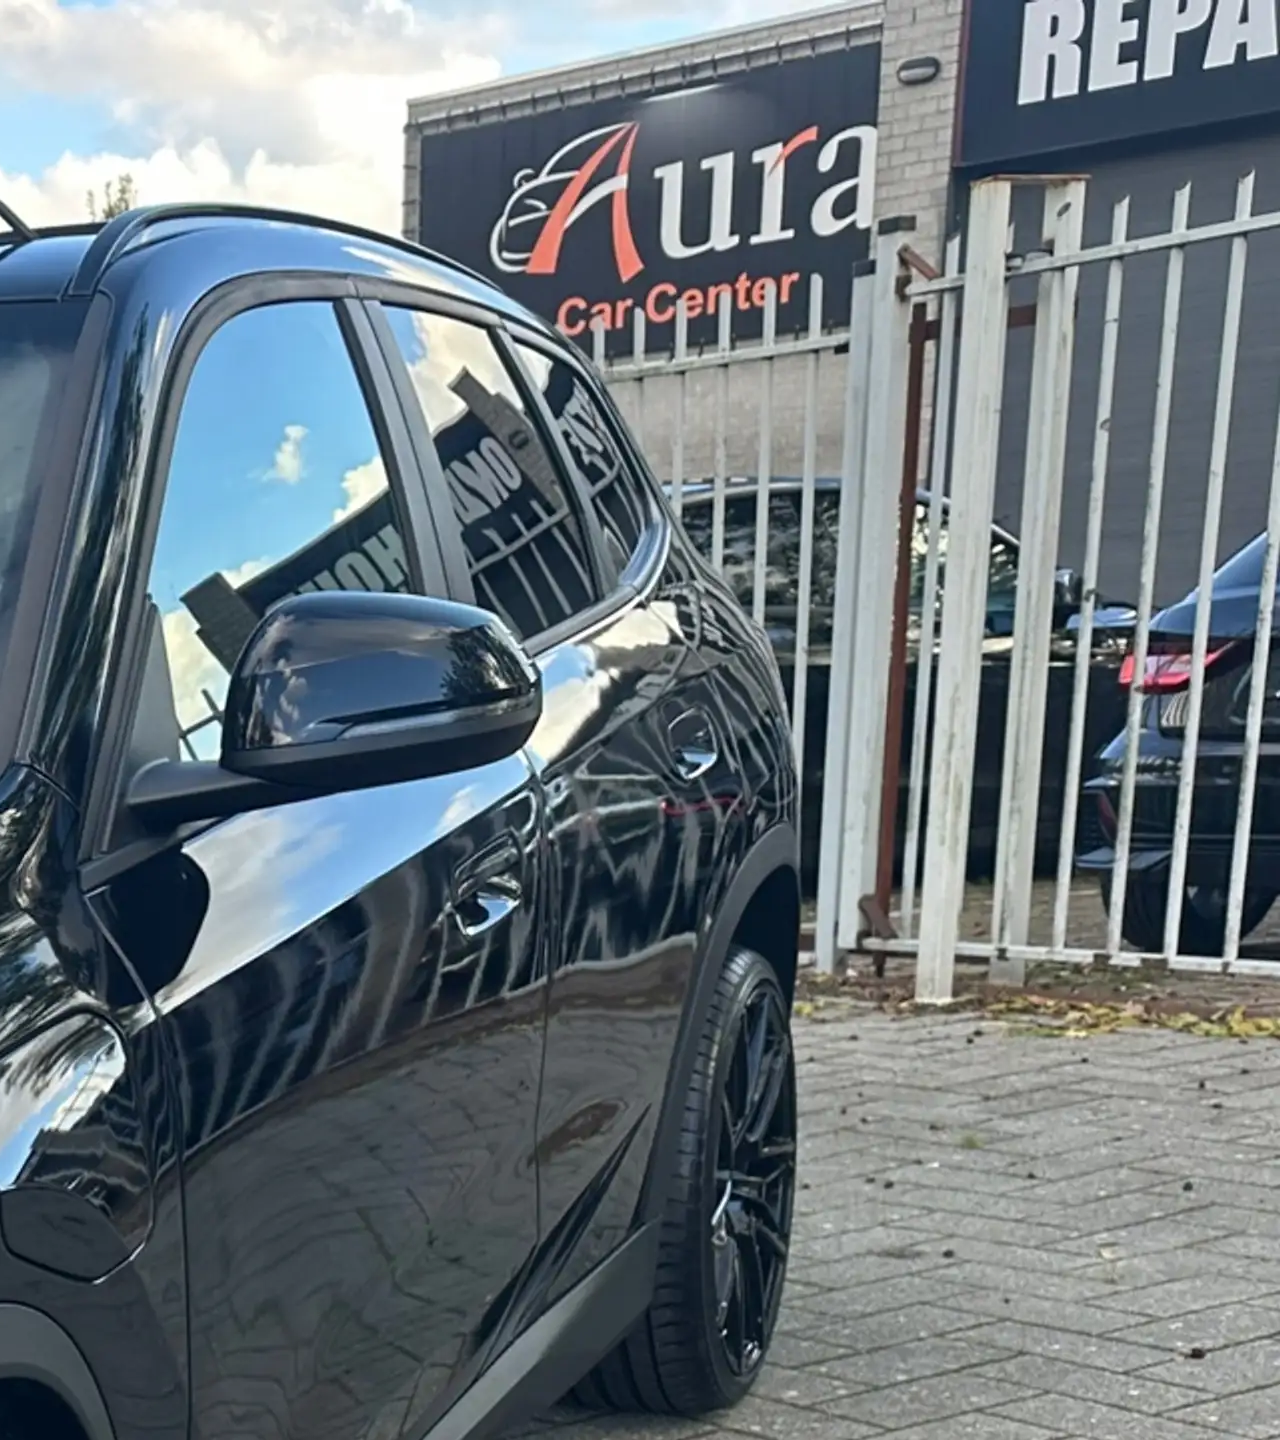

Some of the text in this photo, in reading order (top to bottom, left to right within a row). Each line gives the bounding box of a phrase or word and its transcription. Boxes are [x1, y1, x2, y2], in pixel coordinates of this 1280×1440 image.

[525, 121, 878, 284] Aura
[555, 270, 800, 337] Car Center
